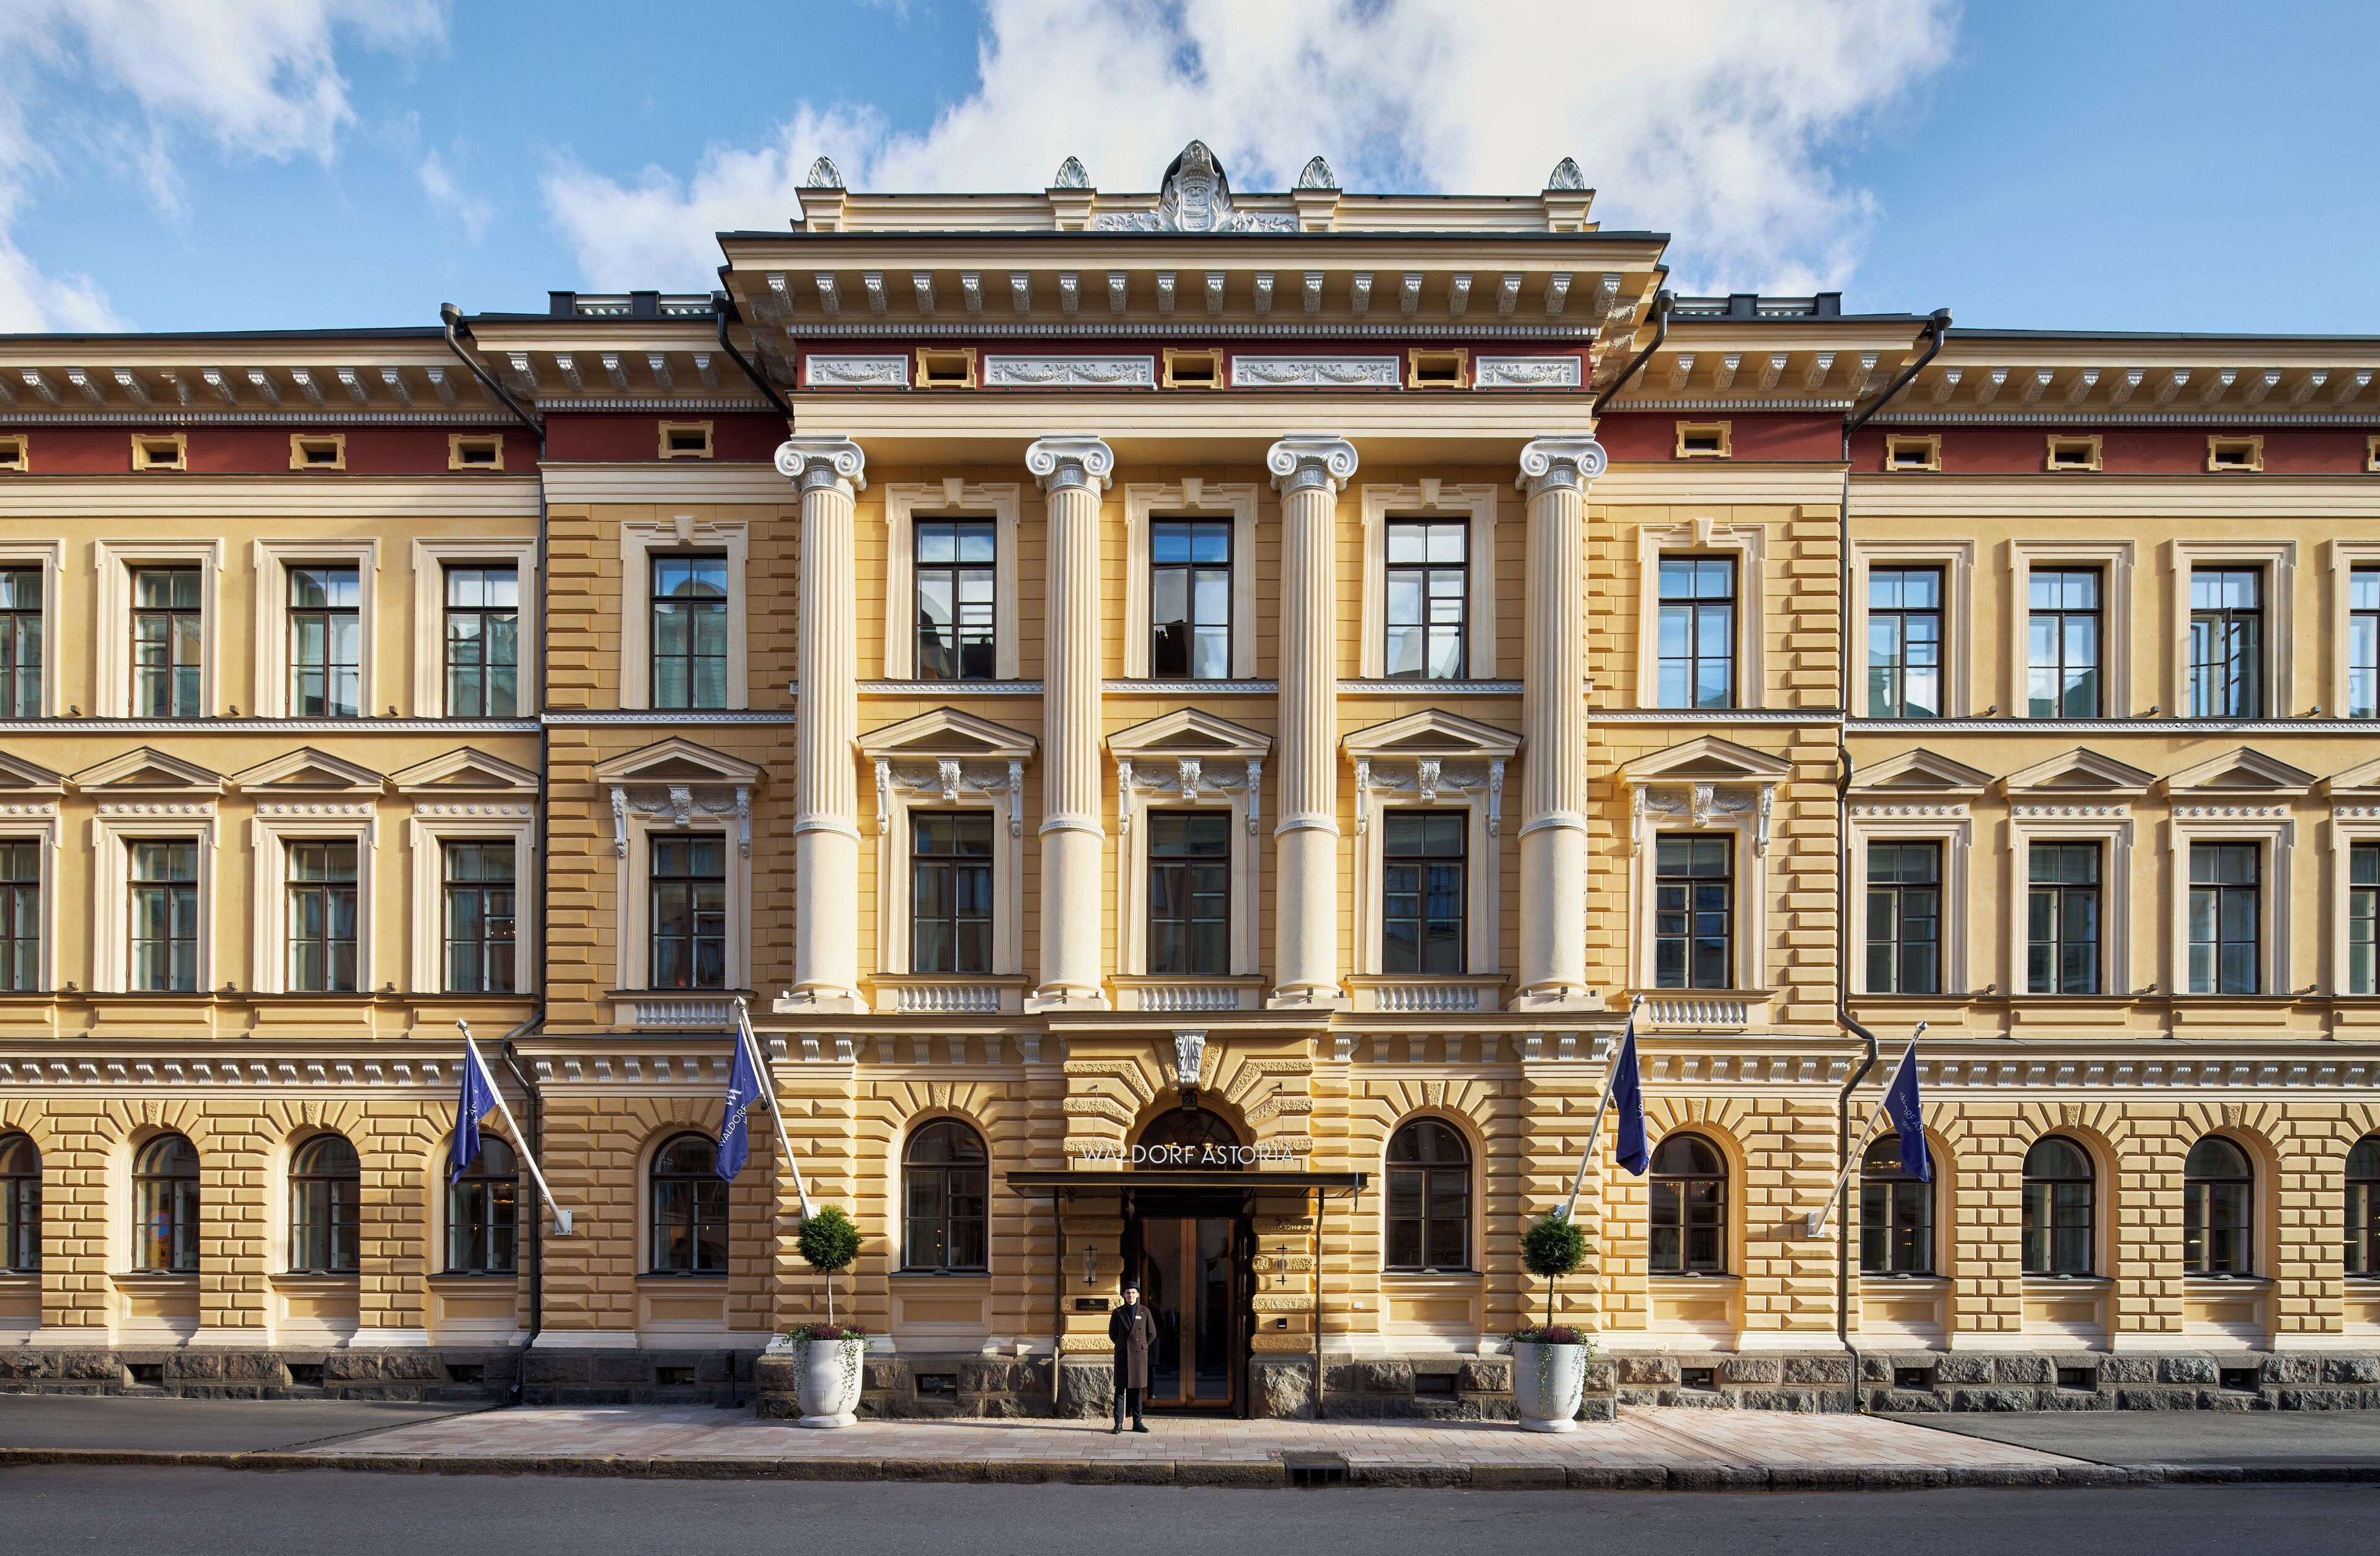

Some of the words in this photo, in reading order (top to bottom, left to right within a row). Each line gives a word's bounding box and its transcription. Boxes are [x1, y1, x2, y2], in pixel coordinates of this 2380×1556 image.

[1184, 1095, 1196, 1106] 23
[718, 1104, 747, 1147] WALDORF
[1080, 1144, 1196, 1164] WALDORF
[1201, 1145, 1296, 1164] ASTORIA
